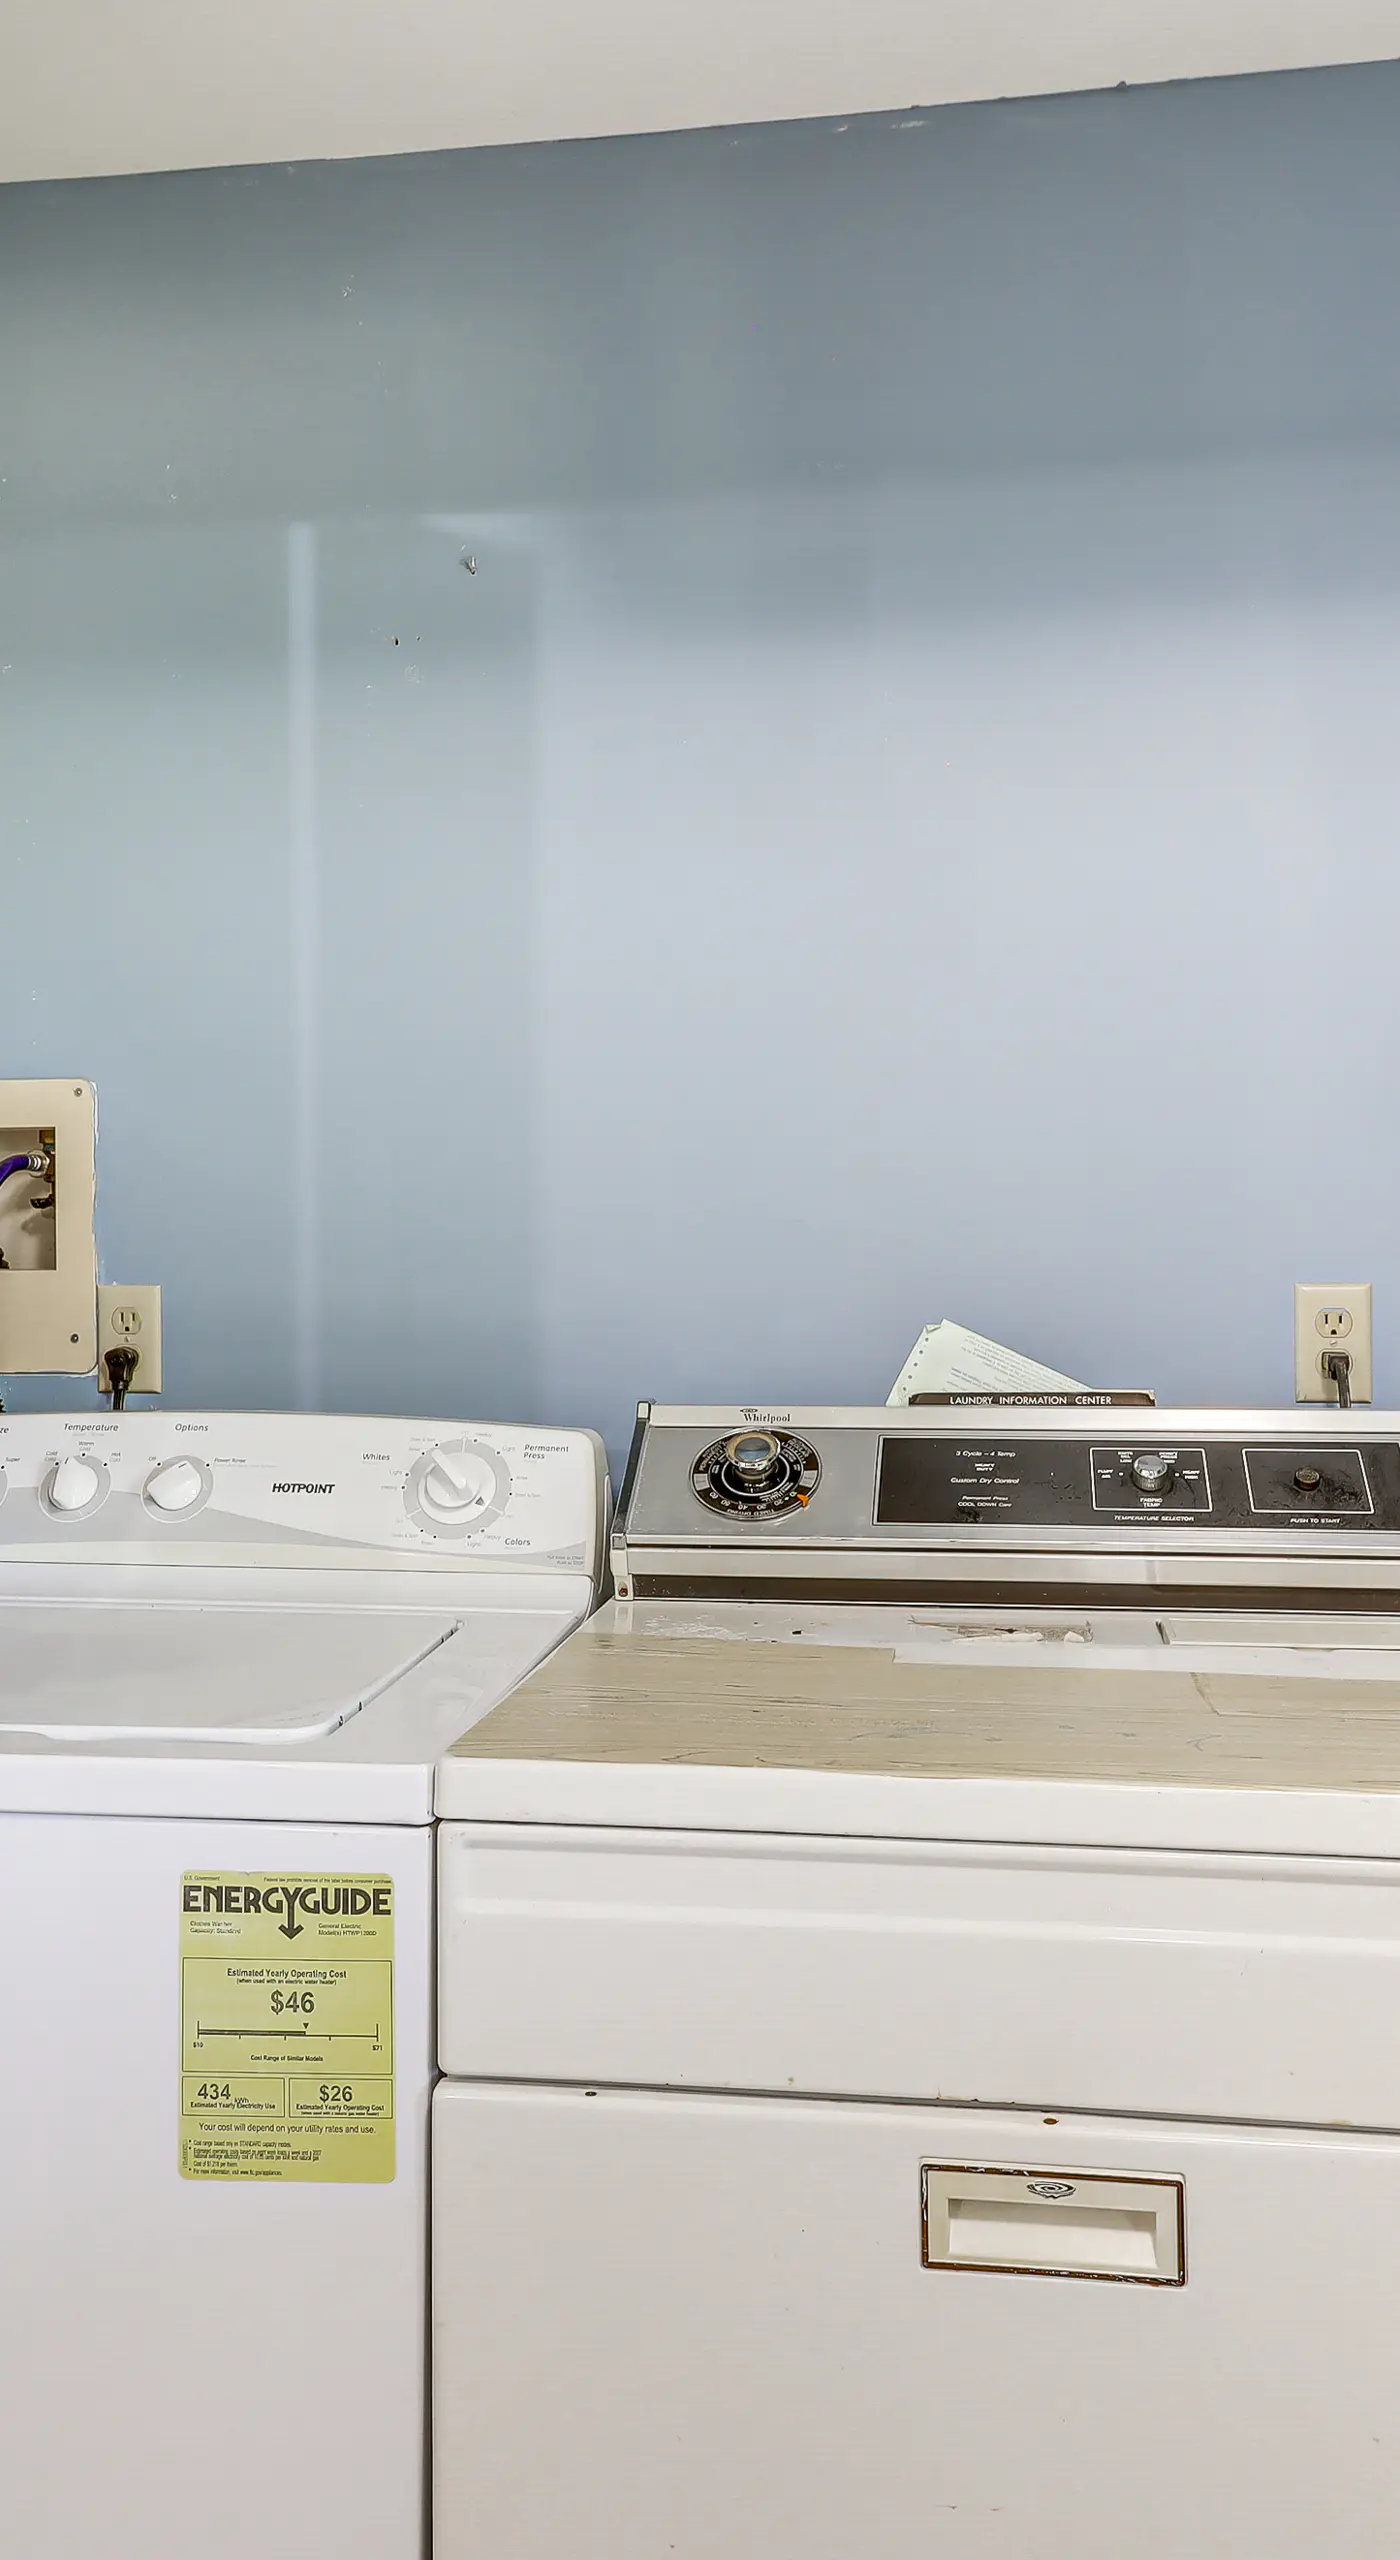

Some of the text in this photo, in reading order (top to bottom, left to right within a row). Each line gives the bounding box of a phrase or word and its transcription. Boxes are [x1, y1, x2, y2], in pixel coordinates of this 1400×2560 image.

[949, 1395, 1112, 1405] LAUNDRY INFORMATION CENTER
[743, 1413, 790, 1424] Whirlpool
[64, 1423, 119, 1432] Temperature
[175, 1423, 209, 1432] Options
[524, 1444, 569, 1452] Permanent
[362, 1453, 391, 1461] Whites
[272, 1483, 335, 1494] HOTPOINT
[504, 1538, 531, 1546] Colors
[183, 1885, 392, 1916] ENERGYGUIDE
[227, 1968, 347, 1980] Estimated Yearly Operating Cost
[270, 1989, 315, 2015] $46
[197, 2083, 231, 2100] 434
[319, 2084, 353, 2103] $26
[219, 2102, 236, 2110] Yearly
[236, 2102, 264, 2110] Electricity
[324, 2104, 342, 2112] Yearly
[343, 2104, 370, 2112] Operating
[199, 2122, 216, 2131] Your
[217, 2123, 233, 2131] cost
[234, 2123, 246, 2132] will
[247, 2124, 274, 2134] depend
[287, 2126, 303, 2134] your
[304, 2124, 324, 2134] utility
[325, 2125, 343, 2133] rates
[345, 2125, 359, 2133] and
[360, 2126, 376, 2134] use.
